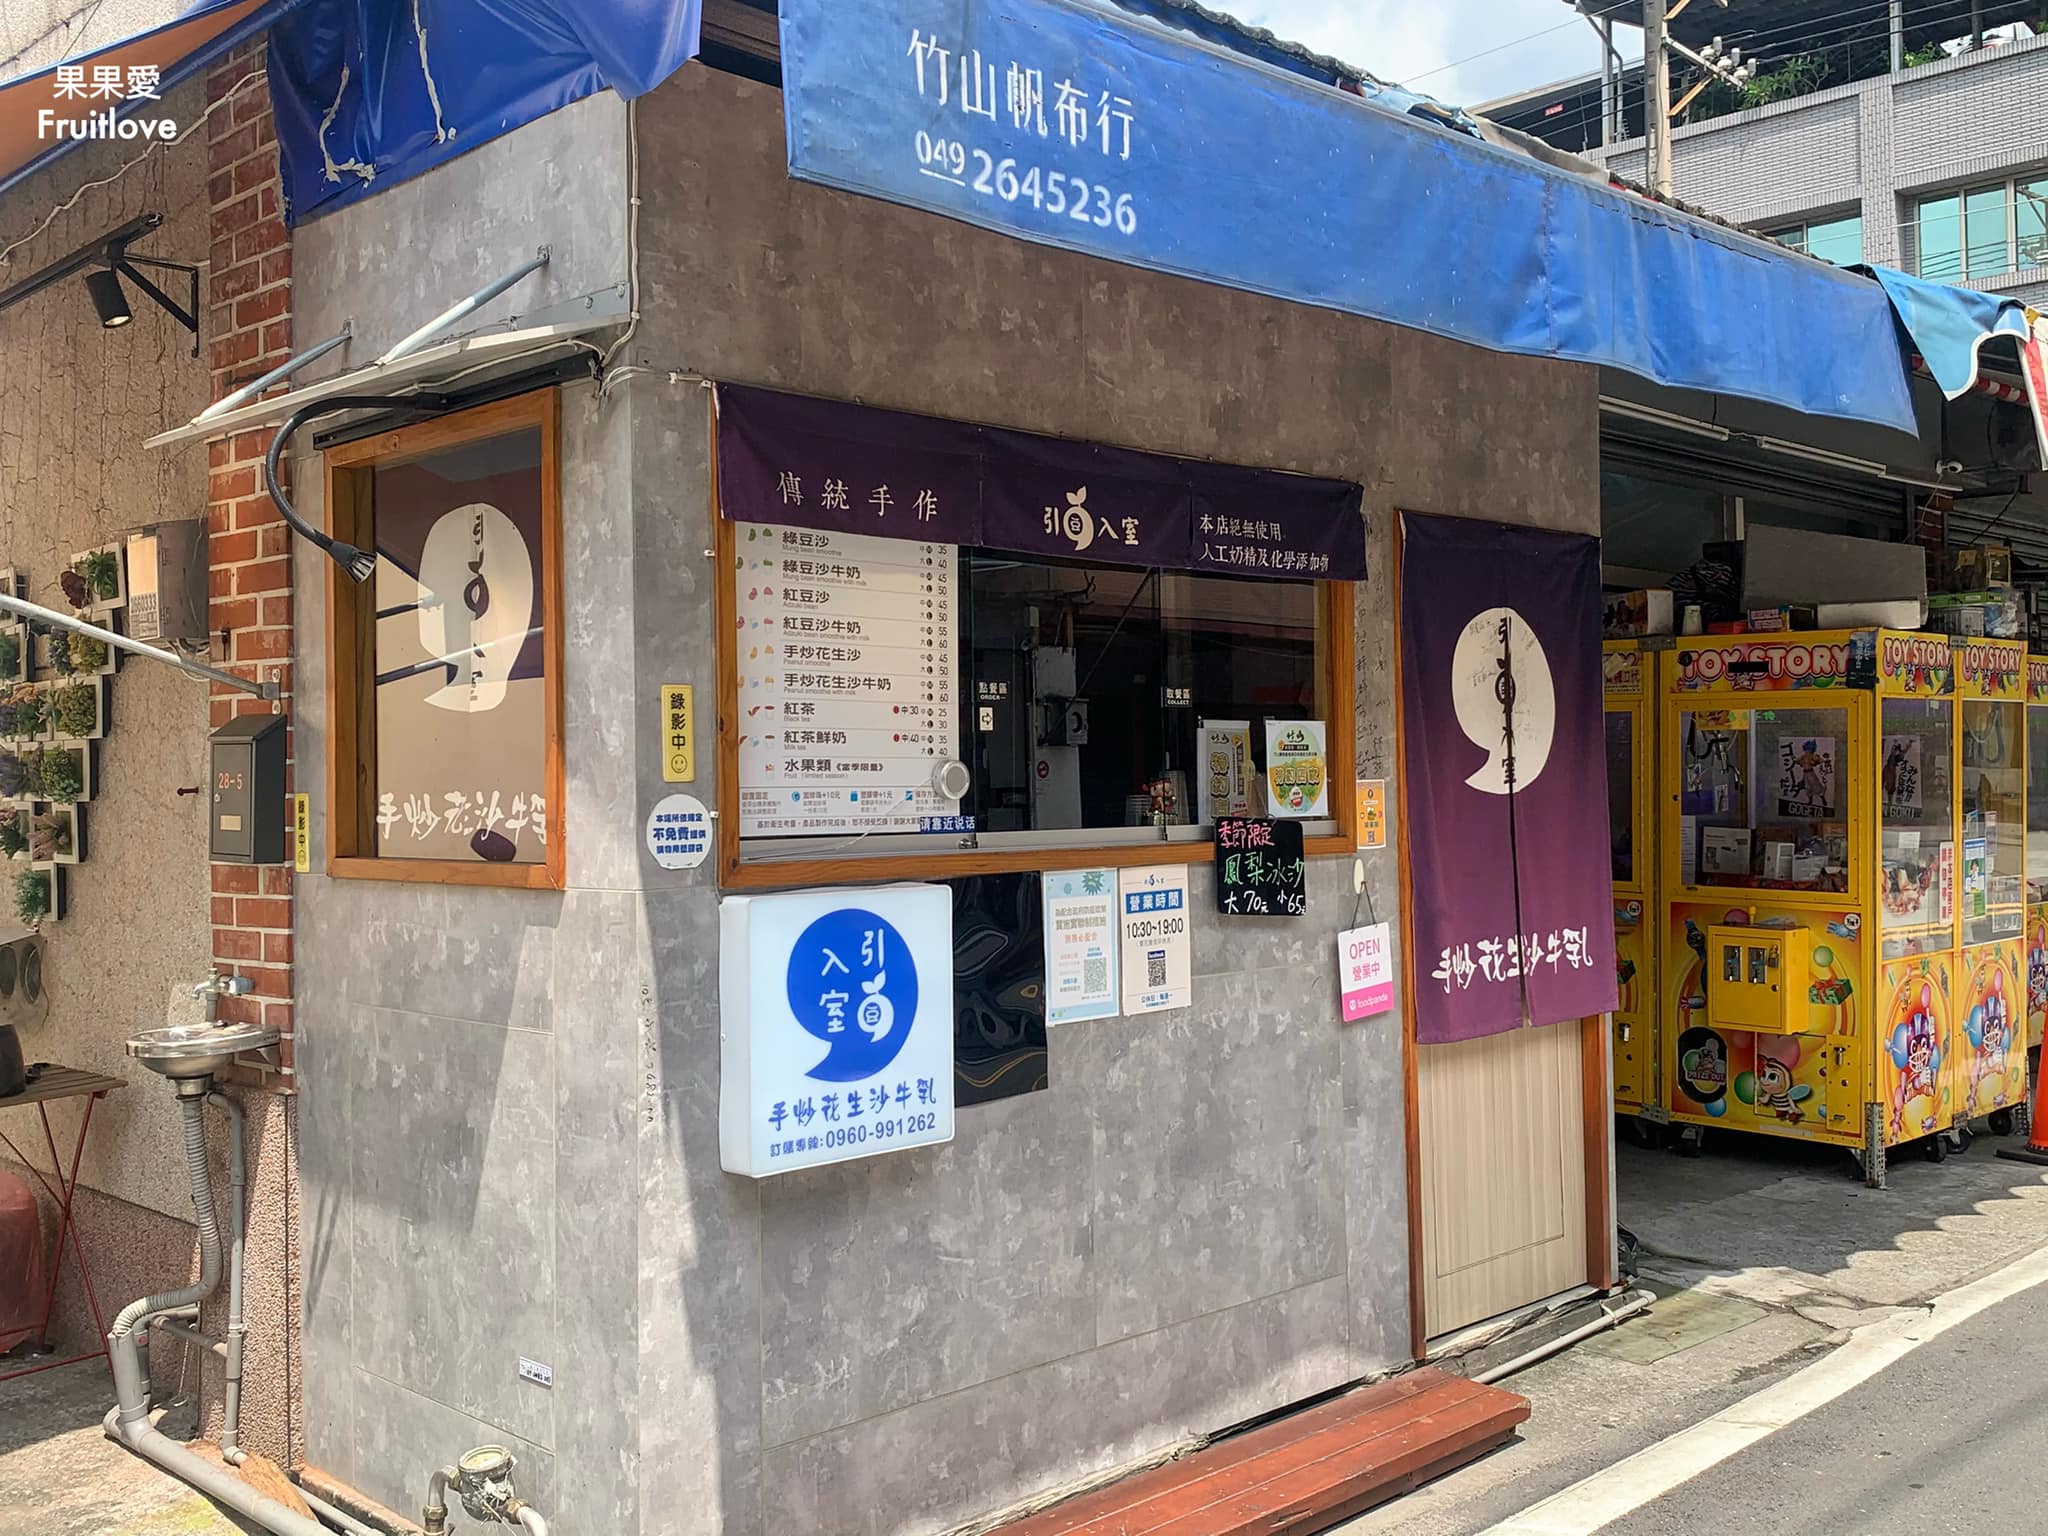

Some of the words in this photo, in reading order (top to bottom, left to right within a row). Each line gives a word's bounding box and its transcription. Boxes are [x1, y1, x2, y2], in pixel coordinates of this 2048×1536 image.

[906, 27, 1135, 161] 竹山帆布行
[914, 129, 967, 175] 049
[972, 149, 1138, 235] 2645236
[776, 471, 940, 522] 傳統手作
[782, 531, 830, 548] 綠豆沙
[782, 559, 861, 580] 綠豆沙牛奶
[783, 587, 830, 604] 紅豆沙
[783, 616, 862, 634] 紅豆沙牛奶
[784, 644, 862, 661] 手炒花生沙
[1884, 637, 1910, 667] TOY
[1913, 640, 1951, 671] STORY
[1988, 647, 2022, 675] STORY
[784, 673, 892, 691] 手炒花生沙牛奶
[784, 702, 815, 715] 紅茶
[670, 692, 686, 750] 錄影中
[784, 730, 847, 744] 紅茶鮮奶
[784, 758, 832, 772] 水果類
[218, 772, 243, 790] 28-5
[1218, 821, 1276, 849] 季節限定
[1224, 851, 1305, 887] 鳳梨冰沙
[1129, 891, 1180, 912] 營業時間
[1126, 917, 1184, 940] 10:30~19:00
[1350, 938, 1380, 960] OPEN
[1352, 961, 1380, 982] 營業中
[768, 1077, 937, 1132] 手炒花生沙牛乳
